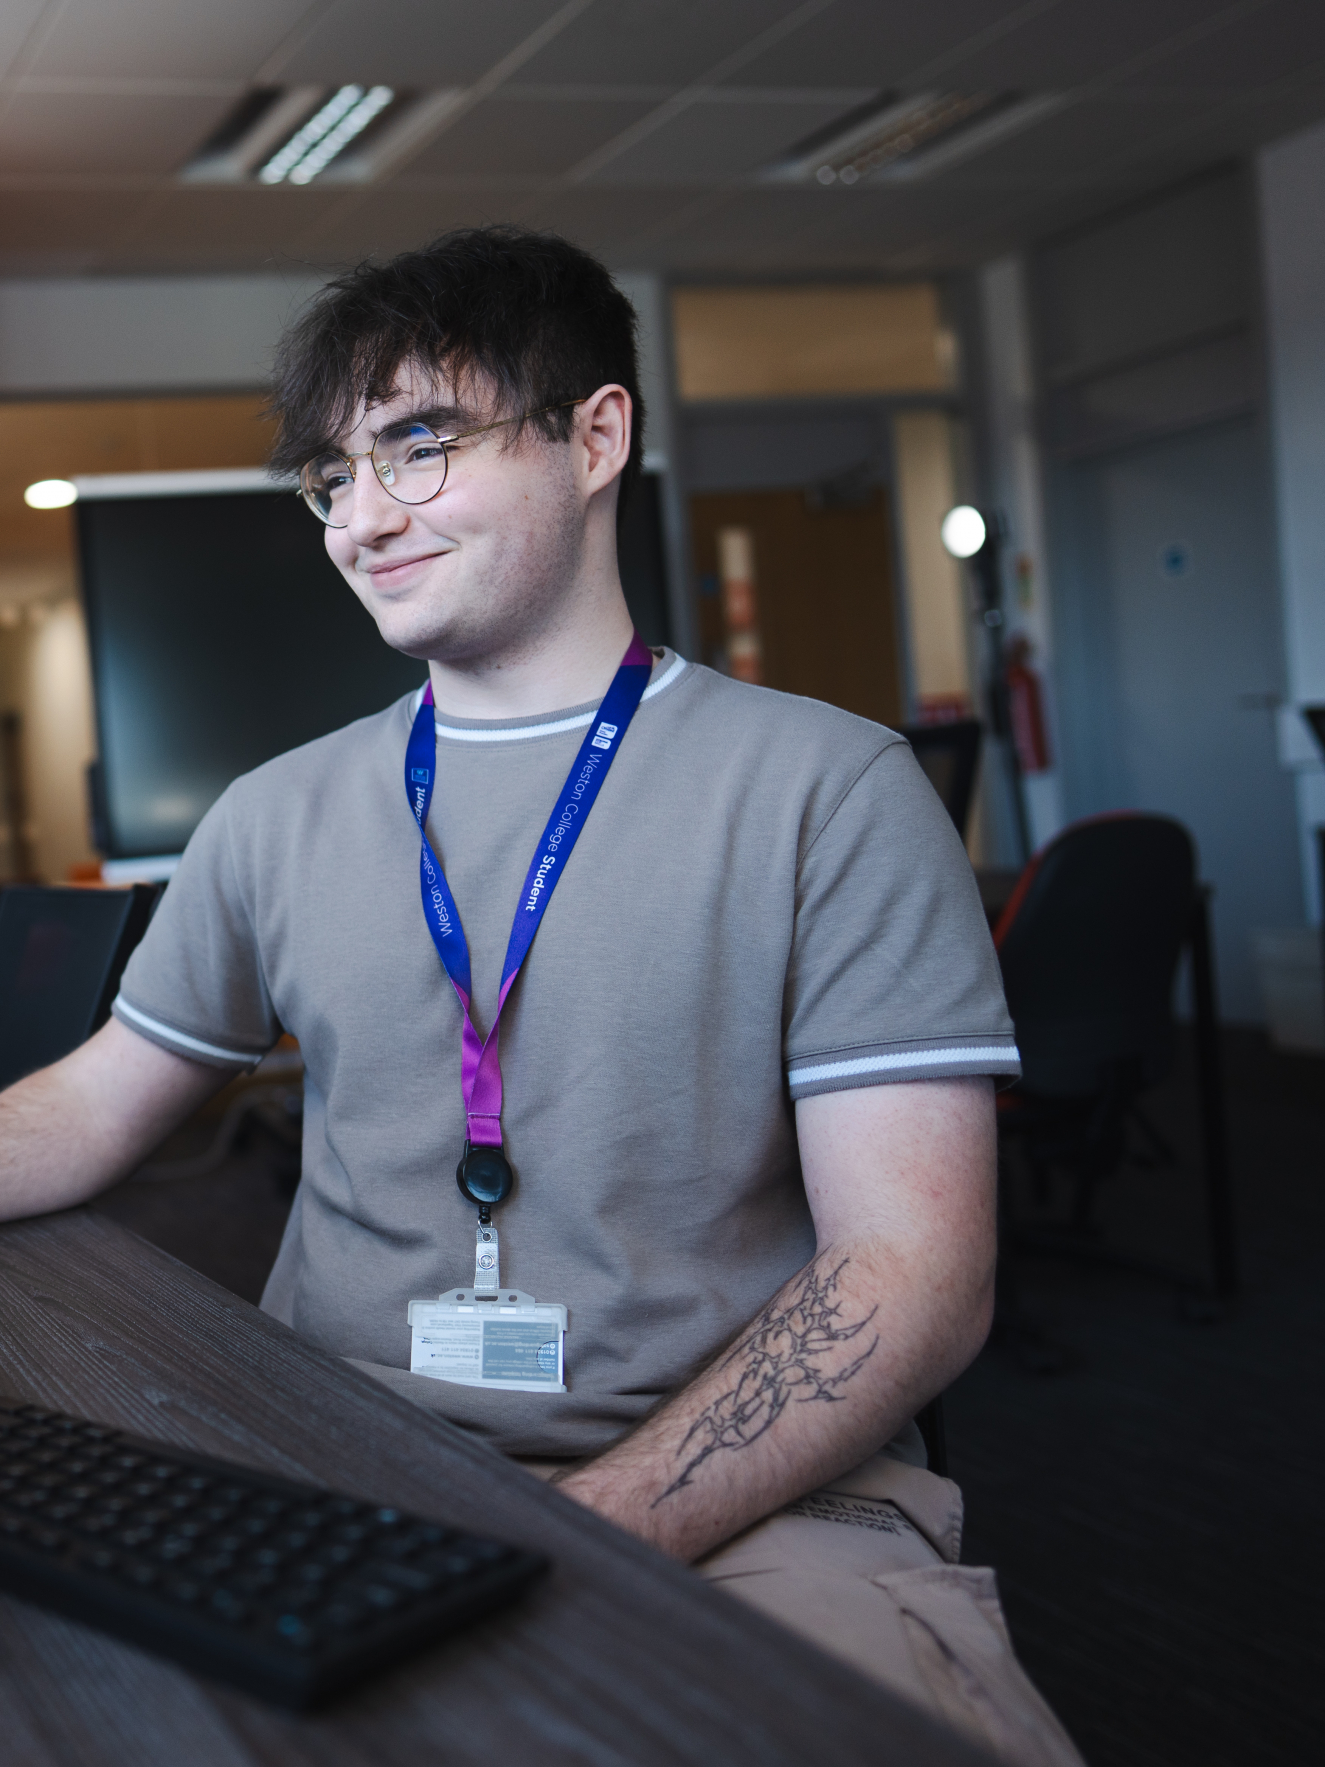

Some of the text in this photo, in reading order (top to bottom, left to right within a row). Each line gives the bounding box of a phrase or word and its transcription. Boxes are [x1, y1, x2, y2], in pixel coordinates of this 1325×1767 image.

[525, 753, 603, 912] Weston College Student
[431, 884, 453, 937] Weston
